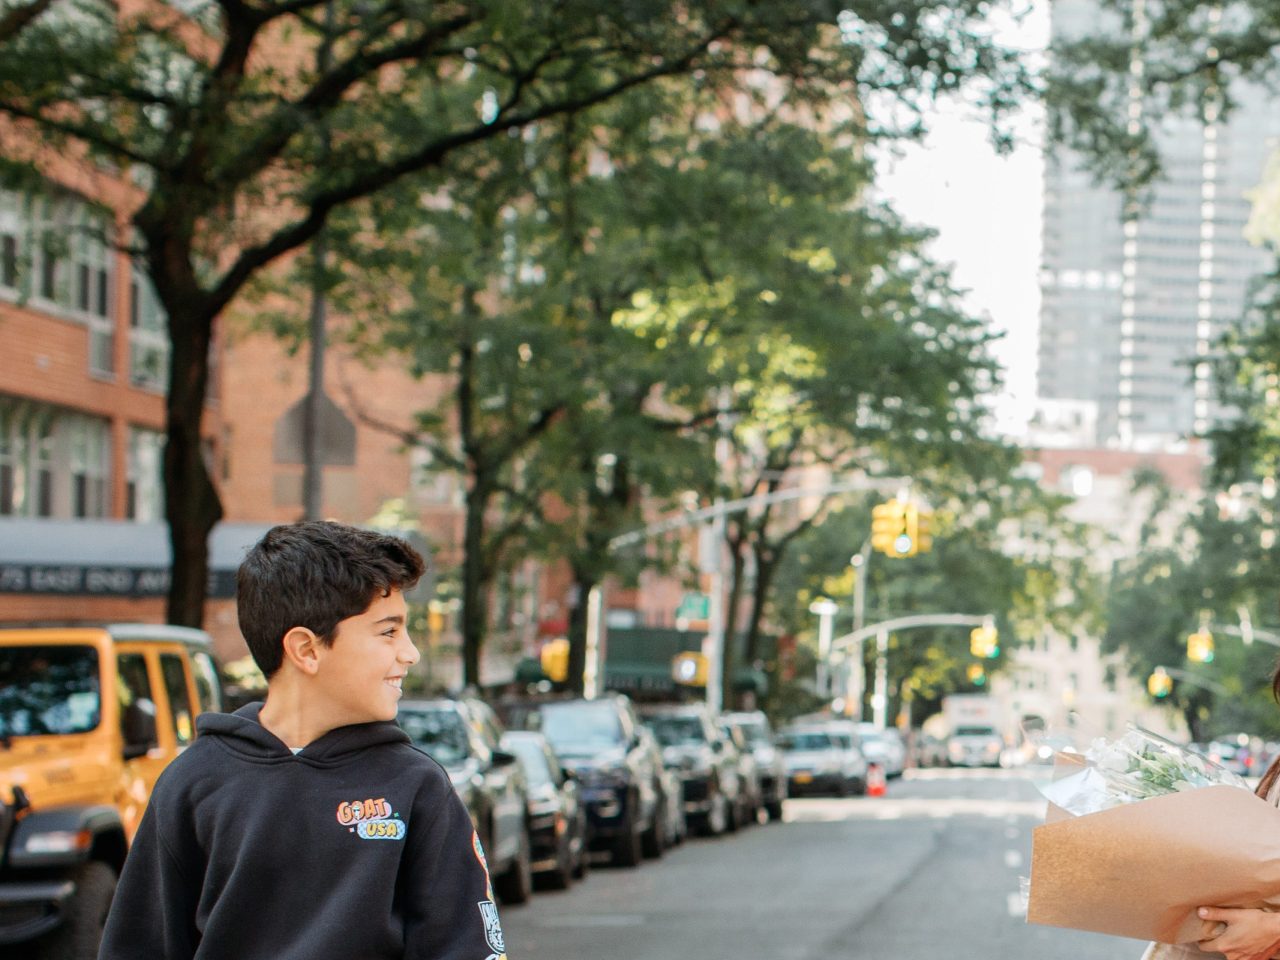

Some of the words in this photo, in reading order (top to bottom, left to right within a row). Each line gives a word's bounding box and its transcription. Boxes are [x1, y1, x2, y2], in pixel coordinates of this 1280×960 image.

[31, 567, 82, 592] EAST
[86, 568, 134, 592] END
[338, 798, 387, 823] GOAT
[366, 823, 398, 837] USA
